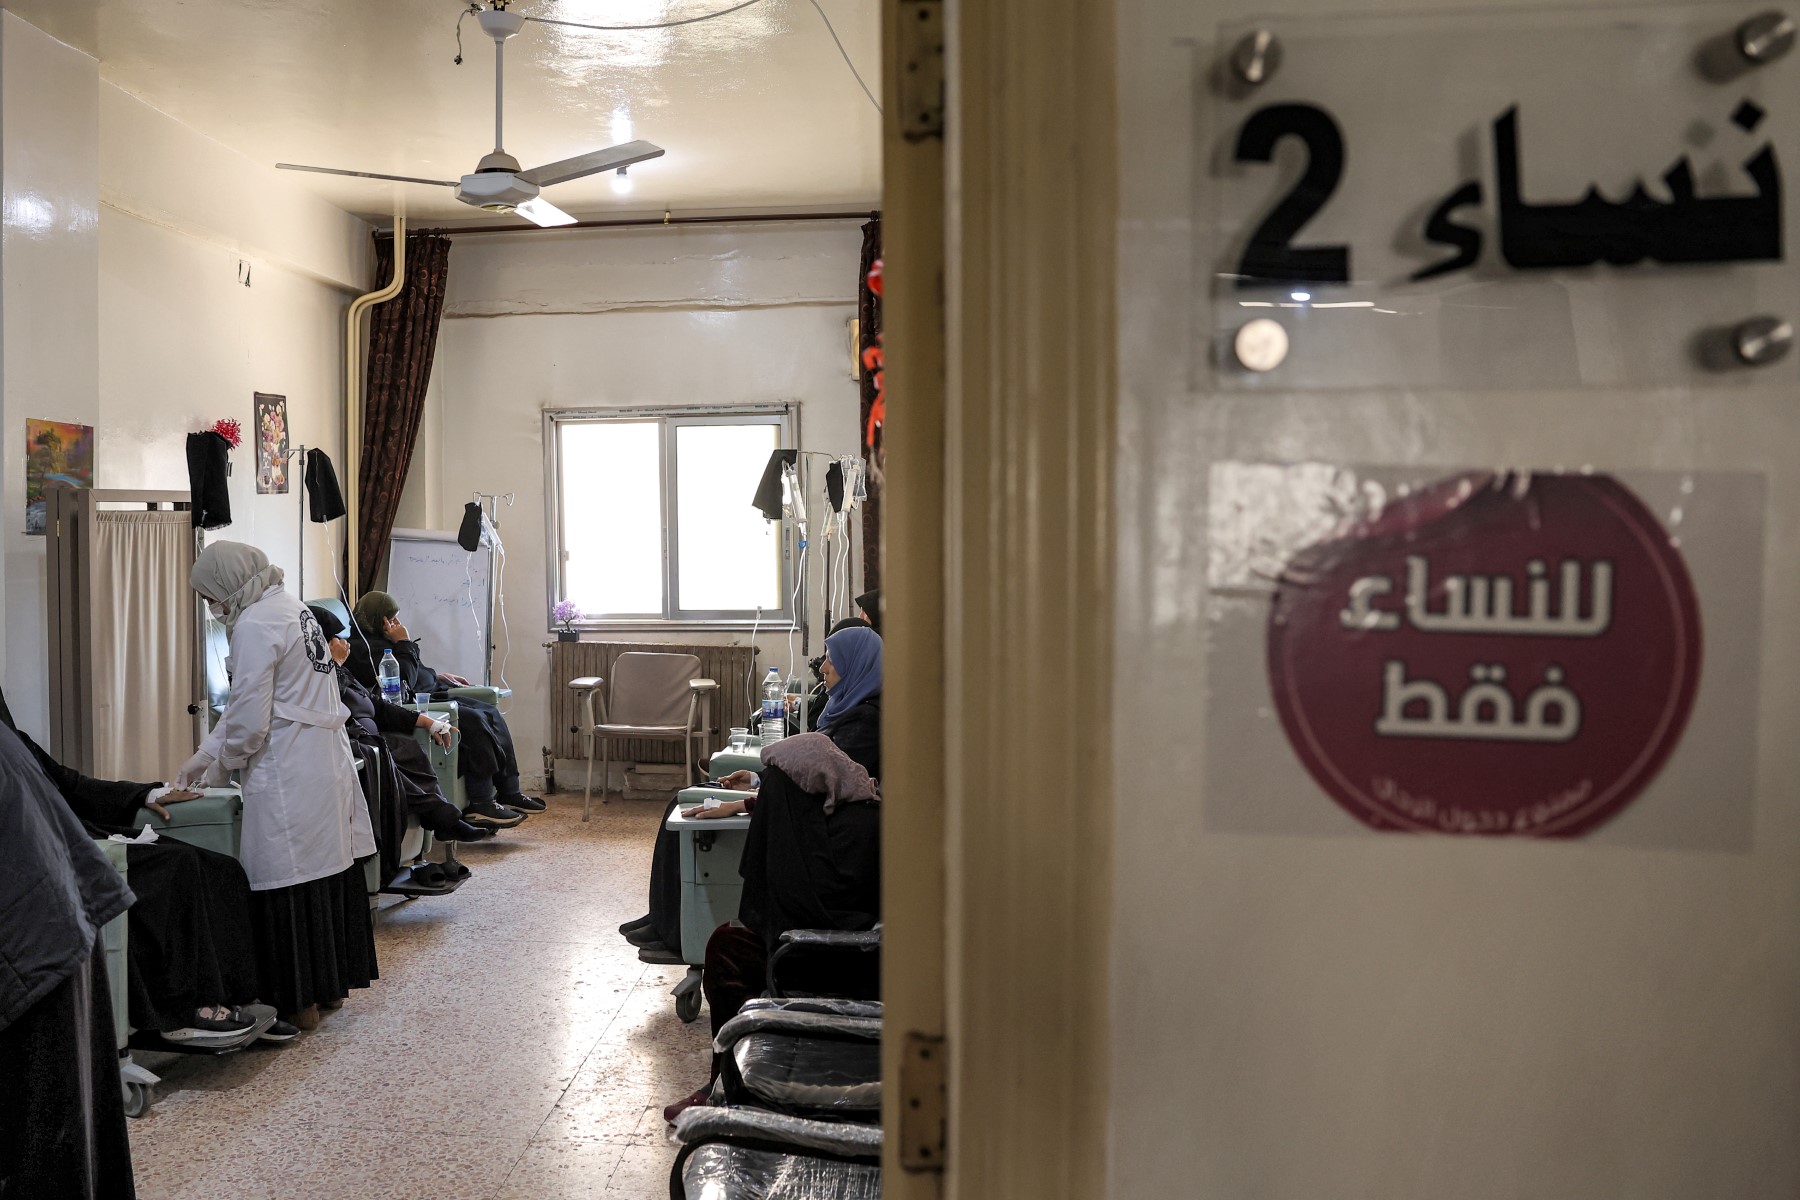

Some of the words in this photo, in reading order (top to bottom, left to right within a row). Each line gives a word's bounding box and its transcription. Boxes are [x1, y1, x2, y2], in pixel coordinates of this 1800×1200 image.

[1233, 103, 1350, 288] 2
[1339, 555, 1613, 637] للنساء
[1374, 660, 1582, 743] فقط
